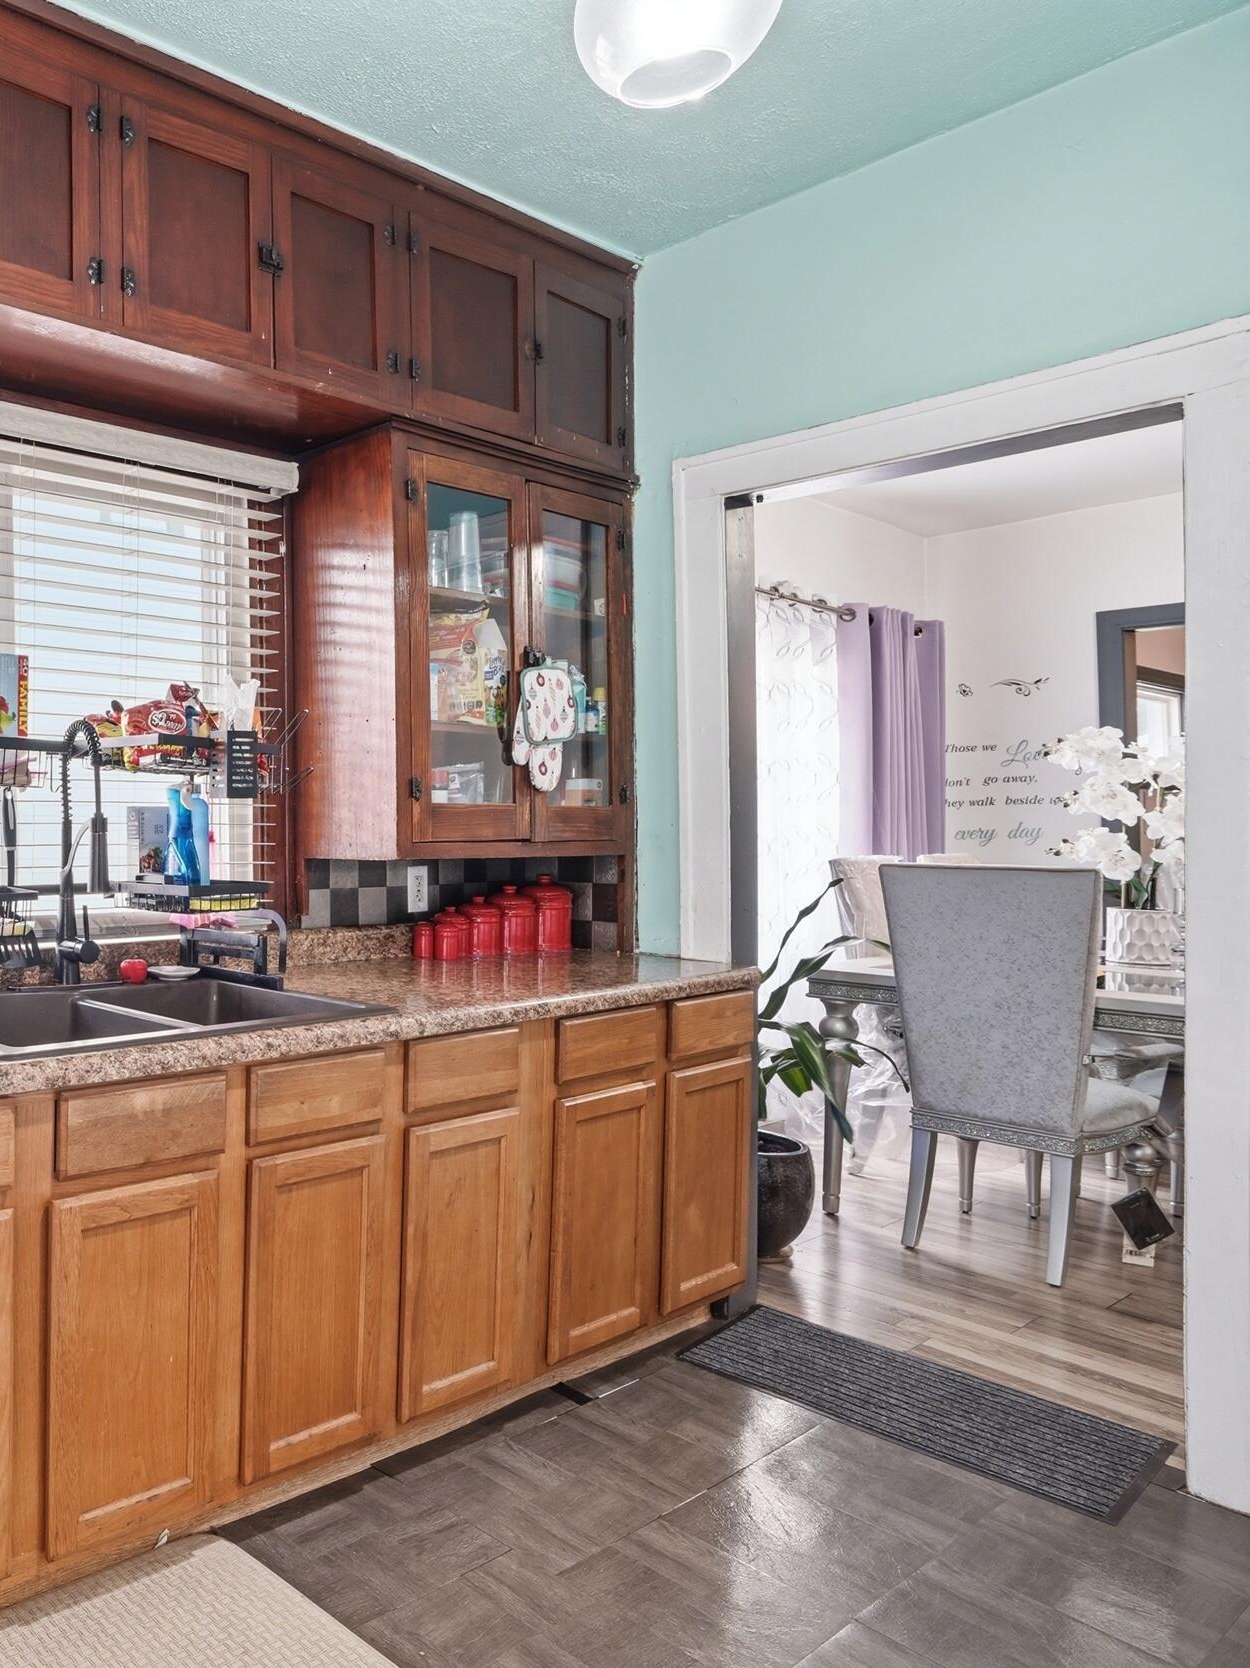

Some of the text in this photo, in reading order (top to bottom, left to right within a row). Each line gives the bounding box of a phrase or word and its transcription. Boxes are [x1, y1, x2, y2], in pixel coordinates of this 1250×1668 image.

[18, 680, 29, 731] FAMILY
[982, 744, 998, 752] we
[982, 775, 999, 787] go
[1002, 775, 1039, 786] away.
[969, 797, 997, 807] walk
[1005, 795, 1045, 806] beside
[954, 822, 1042, 847] every day
